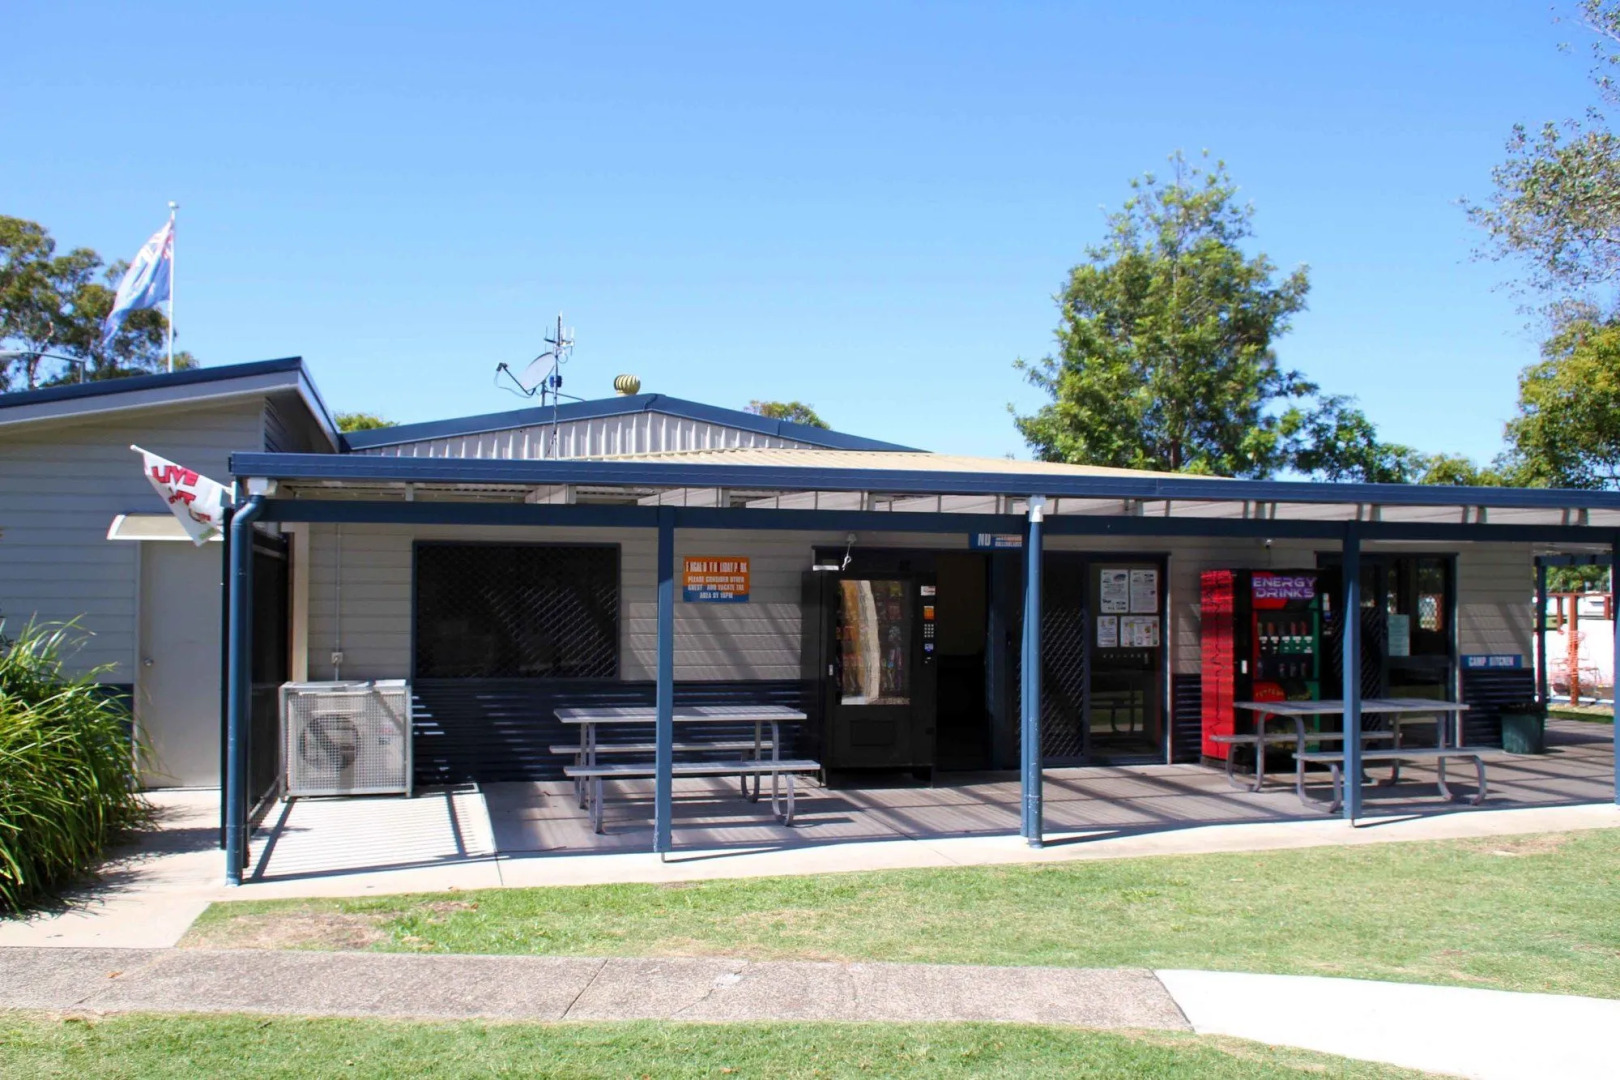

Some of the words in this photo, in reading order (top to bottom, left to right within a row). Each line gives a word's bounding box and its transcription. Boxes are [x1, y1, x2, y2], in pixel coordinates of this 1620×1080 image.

[151, 465, 199, 487] LIVE
[713, 561, 733, 573] HLIDAY
[734, 562, 747, 573] PRK
[1253, 576, 1317, 587] ENERGY
[1256, 587, 1315, 598] DRINKS
[1468, 656, 1487, 667] CAMP
